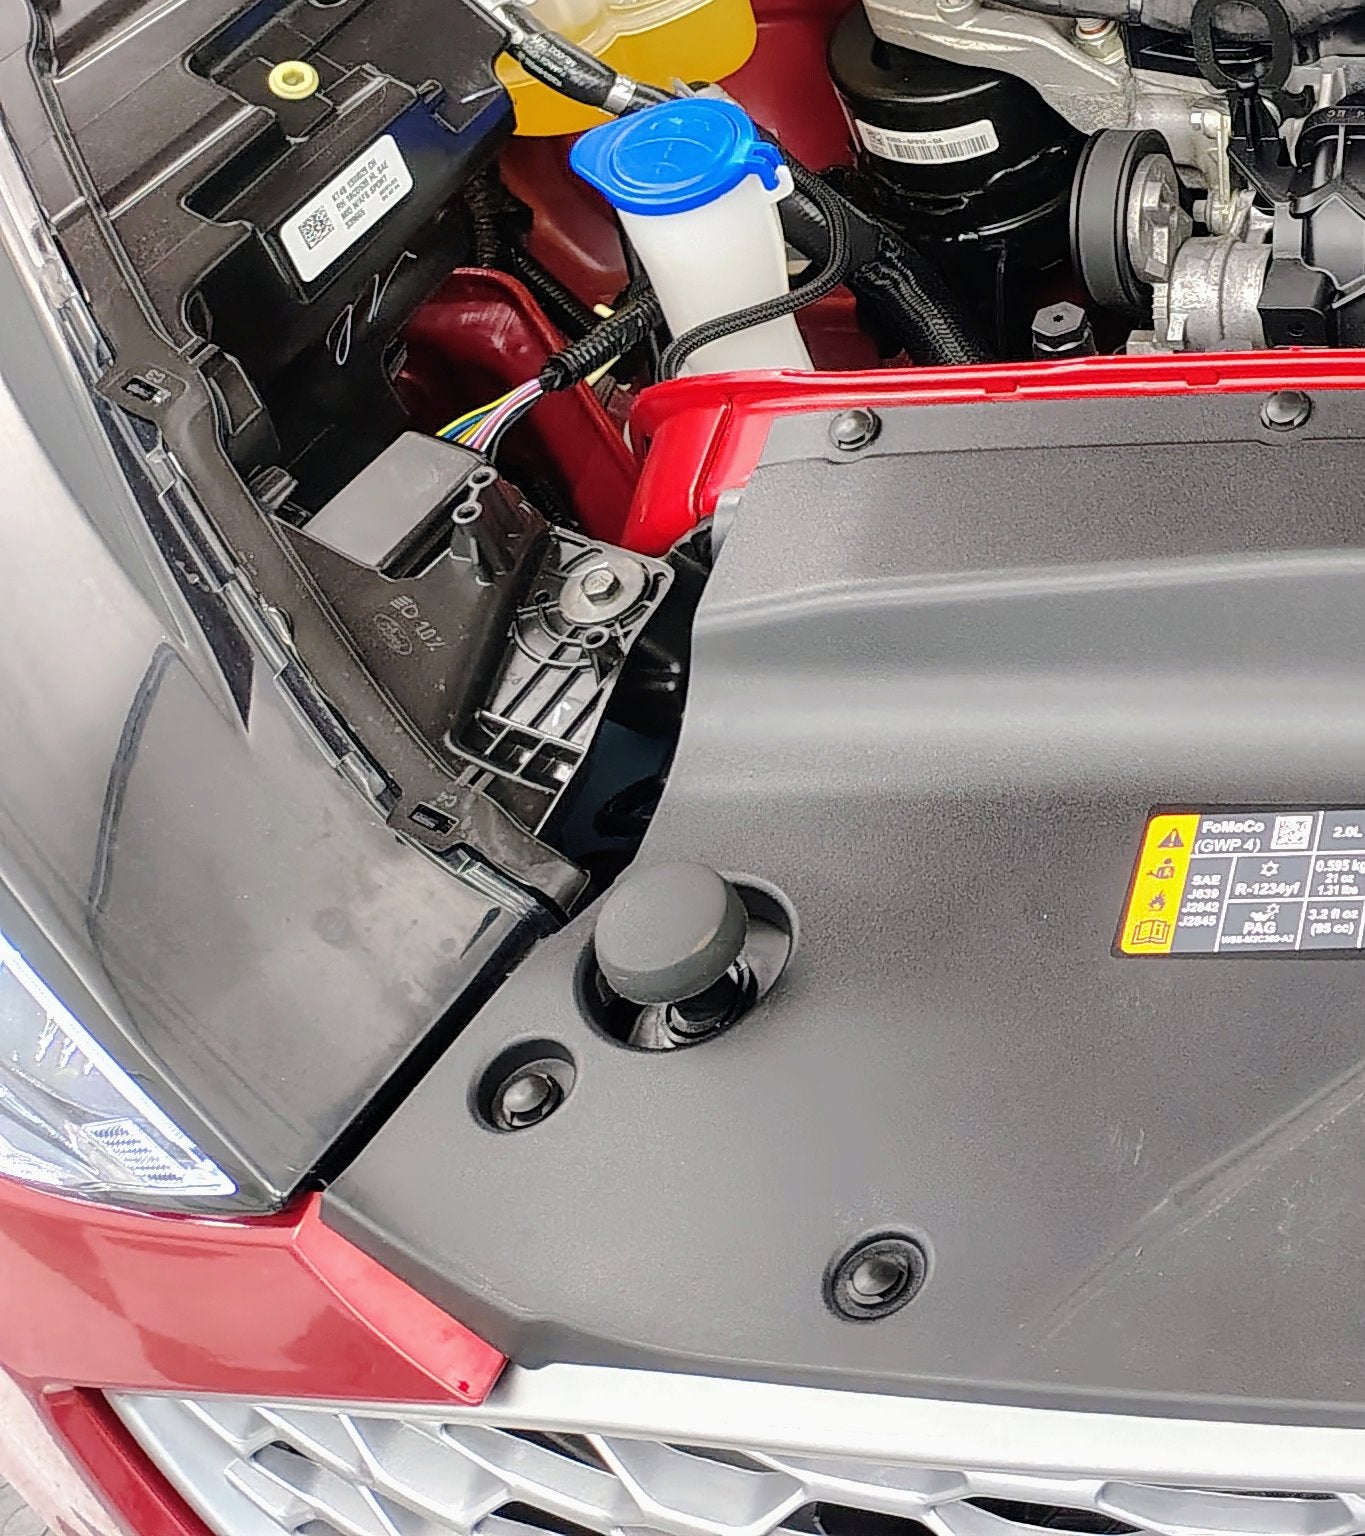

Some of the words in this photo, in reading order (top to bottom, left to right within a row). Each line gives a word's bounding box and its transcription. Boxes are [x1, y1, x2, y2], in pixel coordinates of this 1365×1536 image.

[1201, 819, 1266, 834] FoMoCo
[1332, 825, 1363, 838] 2.0L
[1194, 838, 1241, 855] (GWP
[1242, 837, 1261, 853] 4)
[1191, 874, 1222, 886] SAE
[1340, 874, 1355, 884] oz
[1234, 881, 1301, 897] R-1234yf
[1341, 910, 1359, 919] oz
[1242, 921, 1277, 935] PAG
[1332, 921, 1355, 935] cc)
